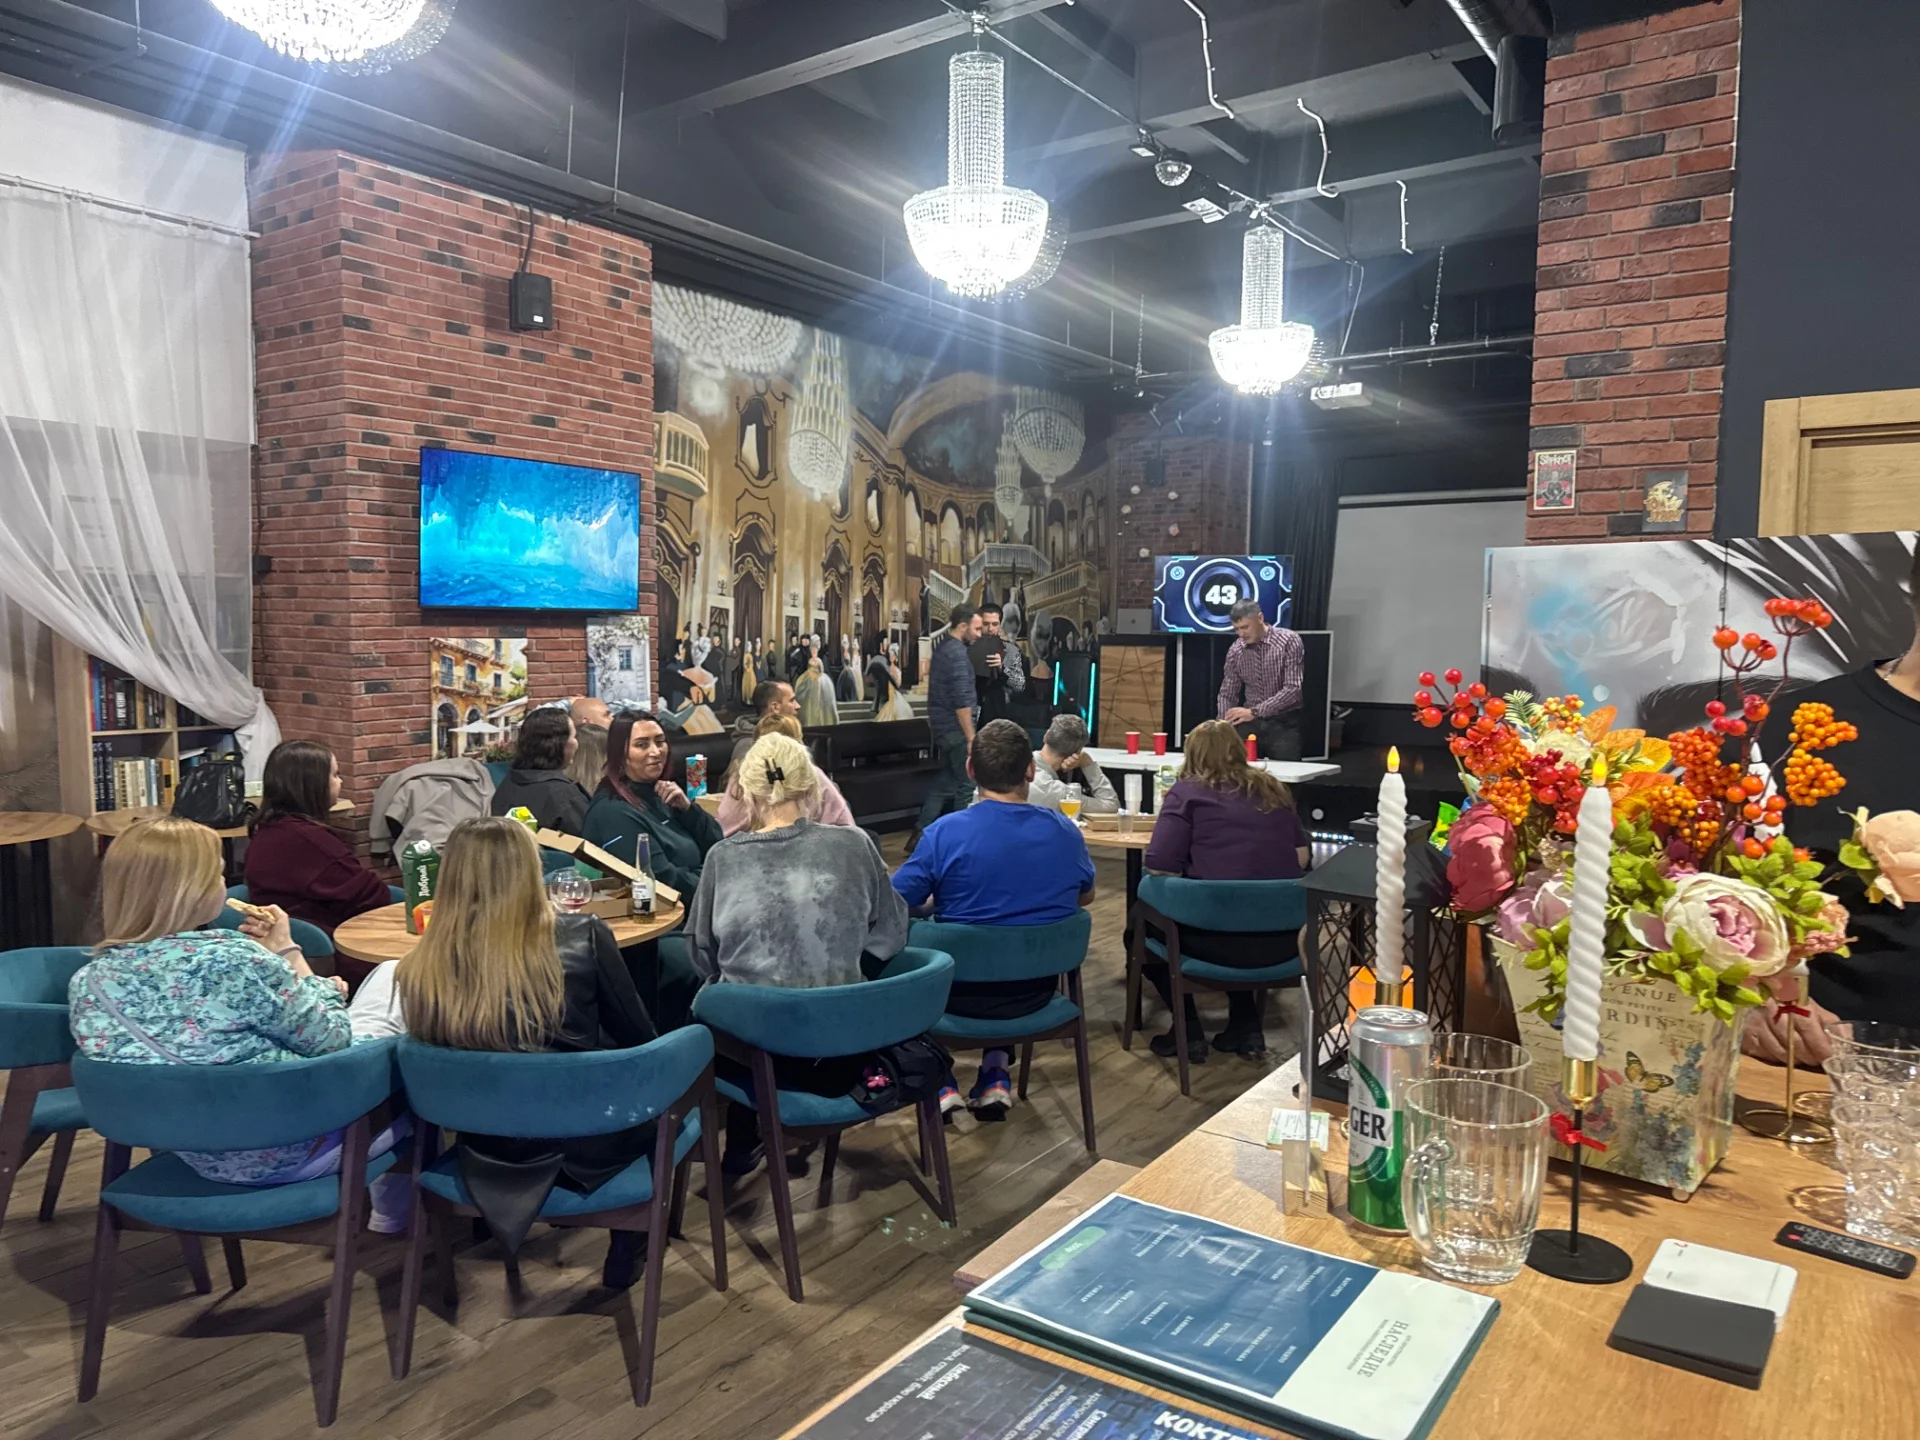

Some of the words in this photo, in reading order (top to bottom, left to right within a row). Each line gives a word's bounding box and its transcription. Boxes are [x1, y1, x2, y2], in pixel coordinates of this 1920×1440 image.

[1205, 585, 1237, 605] 43
[417, 865, 430, 897] Добрый
[1355, 1319, 1411, 1379] НАСЛЕДИЕ
[915, 1360, 948, 1383] спрайт,
[920, 1363, 971, 1400] Небесный
[899, 1381, 922, 1396] блю
[864, 1394, 904, 1422] кюрасао
[1064, 1409, 1108, 1440] Сангри
